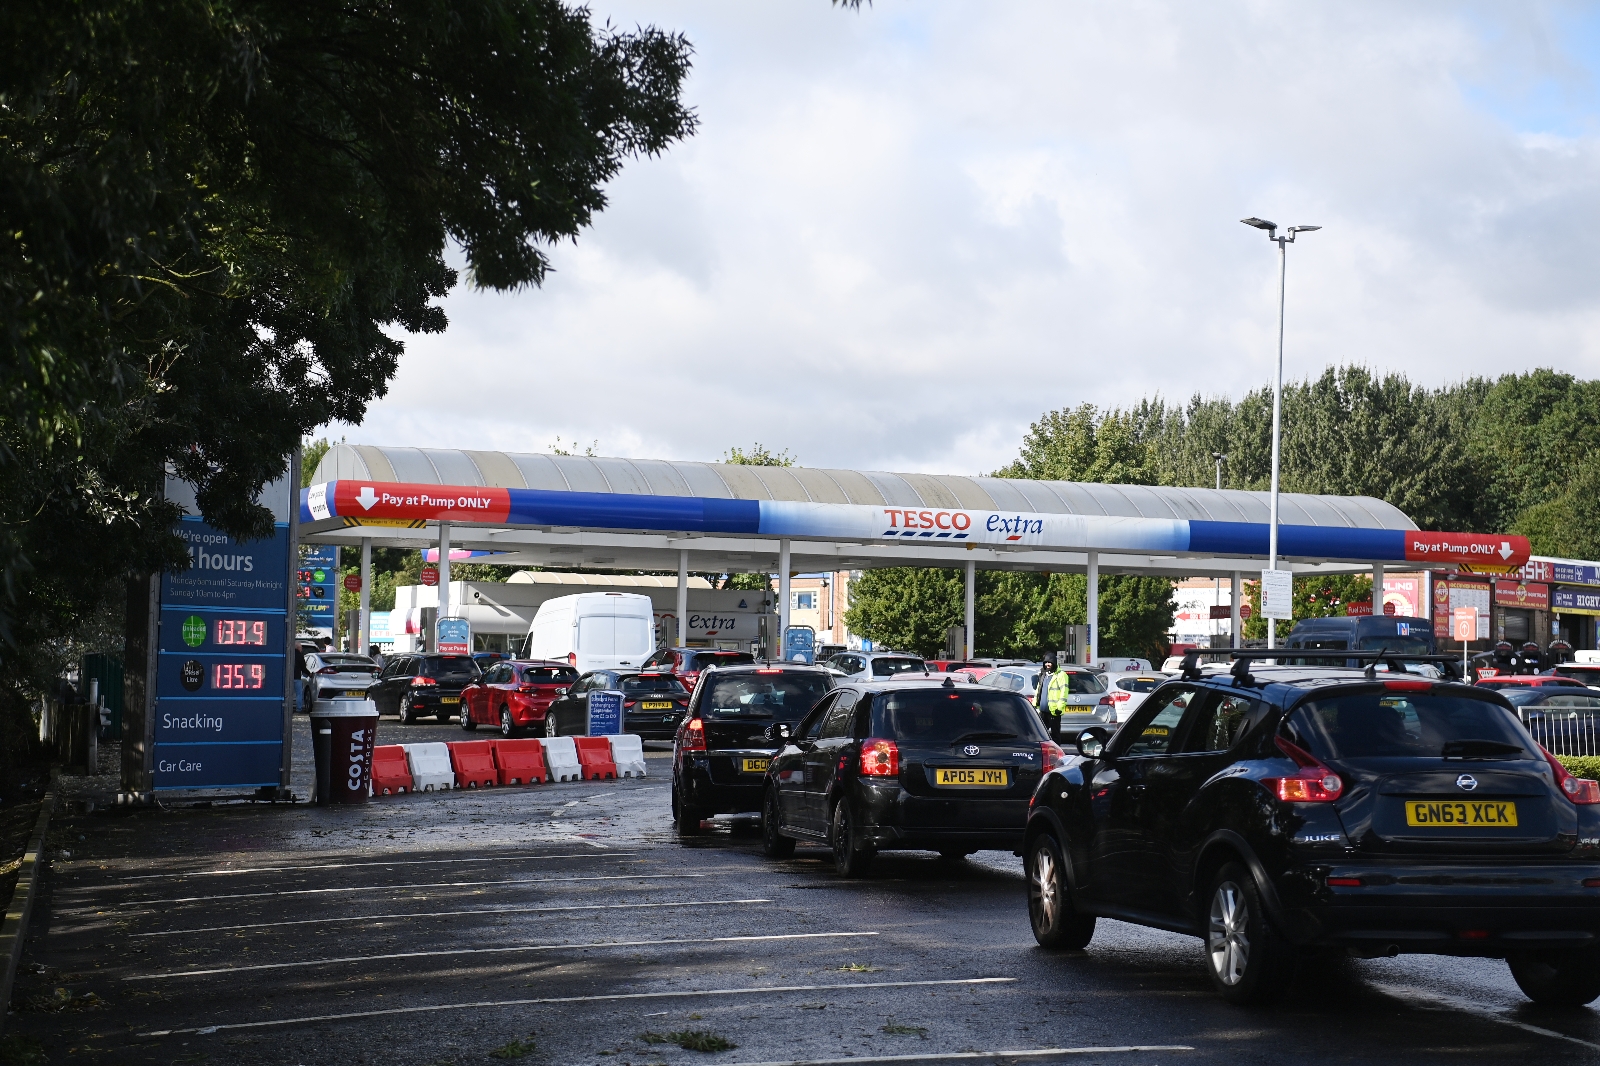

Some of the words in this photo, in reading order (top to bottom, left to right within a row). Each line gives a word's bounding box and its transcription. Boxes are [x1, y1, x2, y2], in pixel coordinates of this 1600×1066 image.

[382, 493, 404, 506] Pay
[406, 496, 418, 506] at
[420, 495, 454, 509] Pump
[458, 497, 491, 508] ONLY
[884, 510, 972, 530] TESCO
[986, 514, 1043, 534] extra
[202, 532, 228, 546] open
[1414, 542, 1430, 554] Pay
[1431, 544, 1440, 552] at
[1442, 543, 1468, 554] Pump
[1470, 544, 1496, 554] ONLY
[198, 546, 254, 572] hours
[212, 578, 226, 586] until
[228, 578, 254, 589] Saturday
[256, 580, 282, 590] Midnight
[170, 588, 194, 598] Sunday
[196, 589, 214, 597] 10am
[689, 614, 736, 630] extra
[218, 620, 264, 645] 133.9
[216, 664, 262, 688] 135.9
[162, 713, 223, 732] Snacking
[159, 760, 176, 772] Car
[178, 760, 202, 772] Care
[348, 729, 364, 790] COSTA
[943, 770, 974, 782] AP05
[979, 771, 1002, 783] JYH
[1415, 804, 1467, 823] GN63
[1473, 804, 1509, 823] XCK
